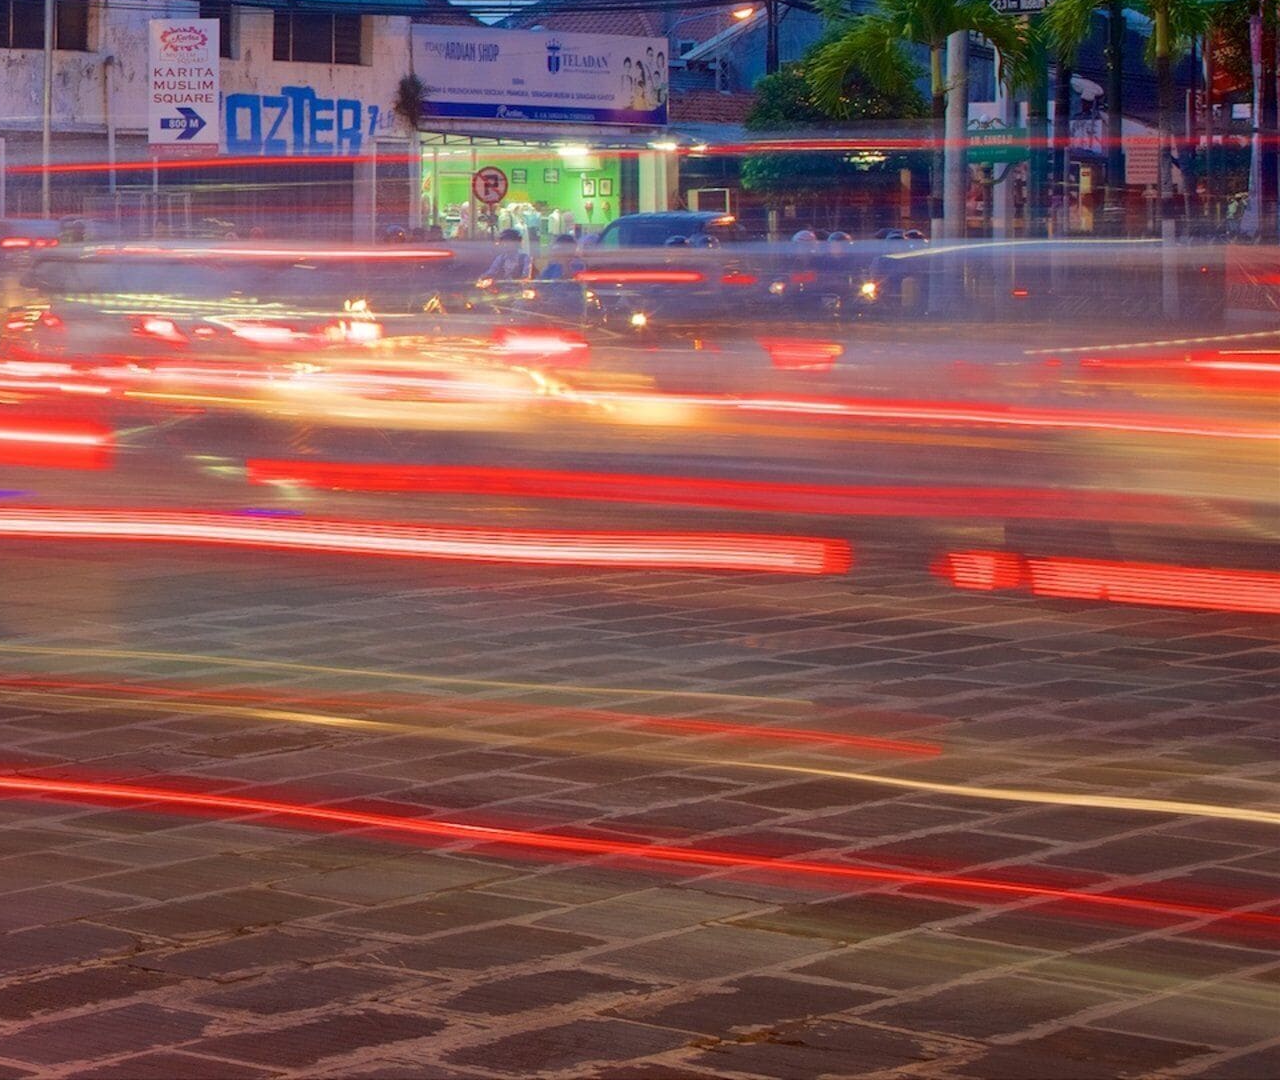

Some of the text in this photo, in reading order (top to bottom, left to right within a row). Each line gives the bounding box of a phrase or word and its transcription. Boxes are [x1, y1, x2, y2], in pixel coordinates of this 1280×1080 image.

[562, 53, 609, 69] TELADAN
[153, 67, 215, 78] KARITA
[153, 80, 214, 90] MUSLIM
[153, 93, 215, 104] SQUARE
[168, 118, 200, 129] 800 M
[226, 85, 363, 156] OZTER
